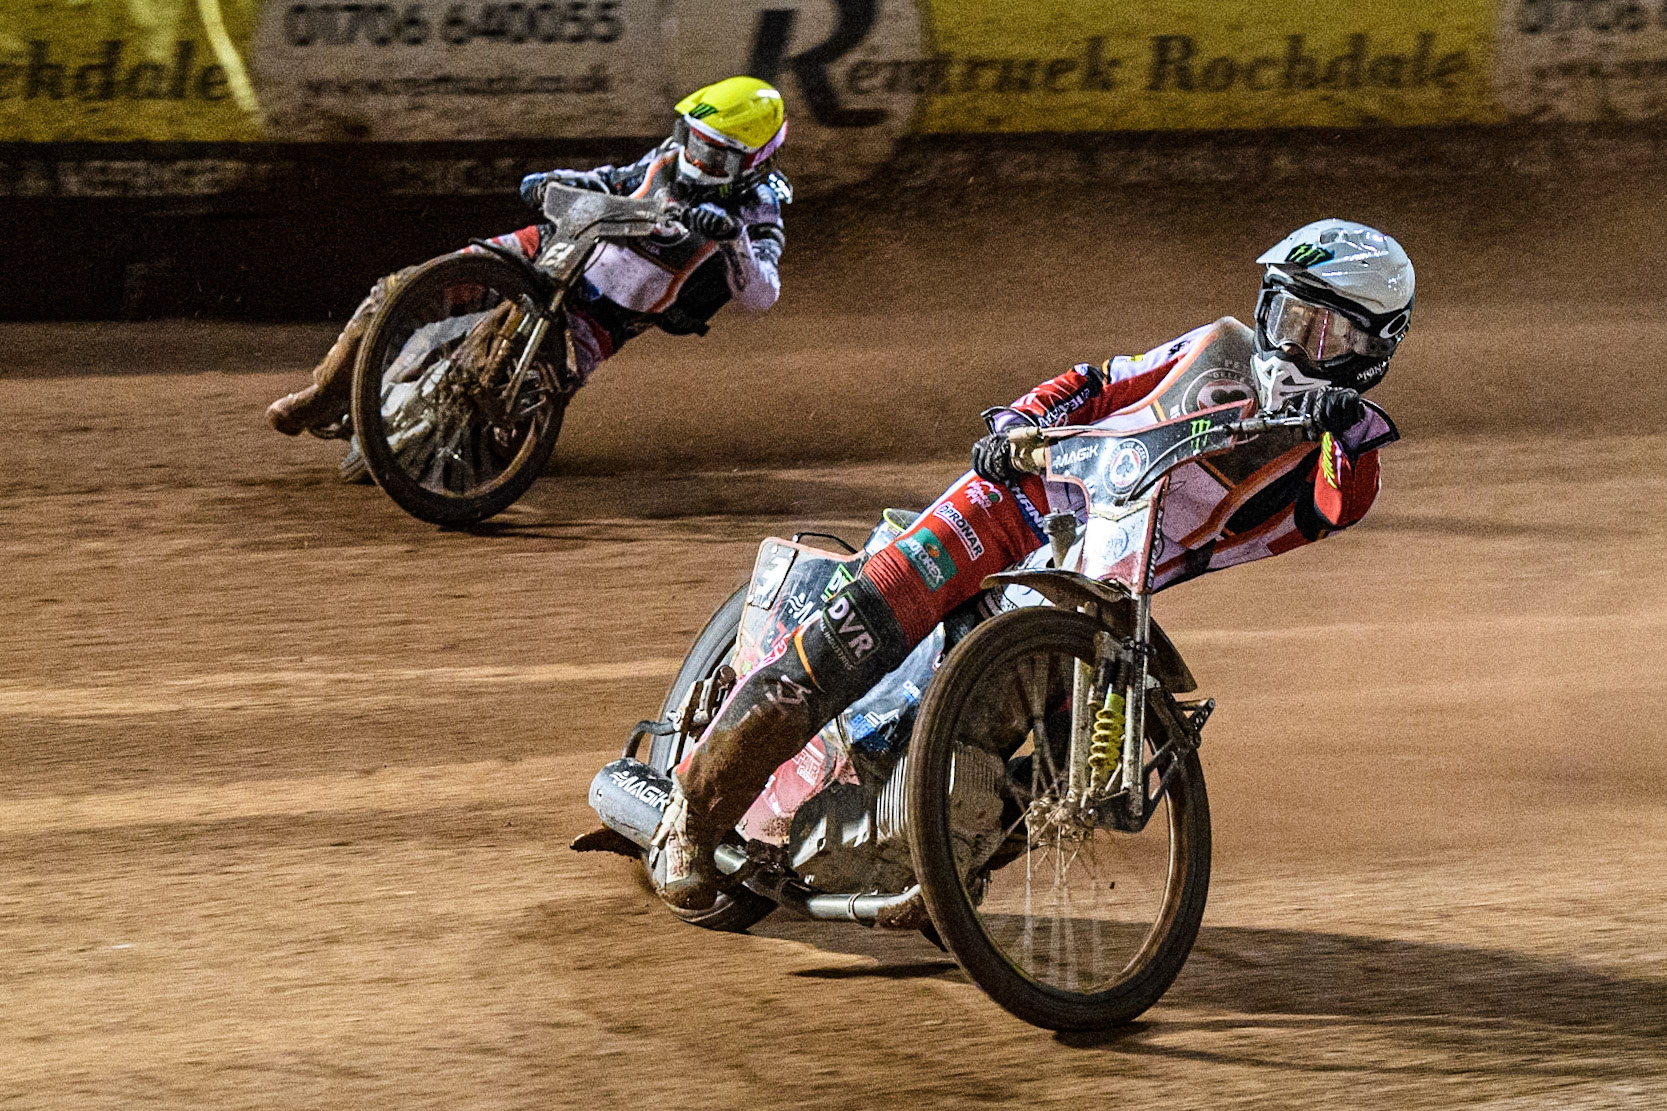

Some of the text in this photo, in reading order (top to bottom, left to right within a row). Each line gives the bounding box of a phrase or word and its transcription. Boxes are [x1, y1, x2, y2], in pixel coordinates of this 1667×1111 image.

[1145, 32, 1471, 93] Rochdale
[943, 504, 984, 557] PRONAR
[904, 536, 946, 585] MOTOREX
[827, 595, 875, 660] DVR
[611, 771, 670, 813] MAGIK
